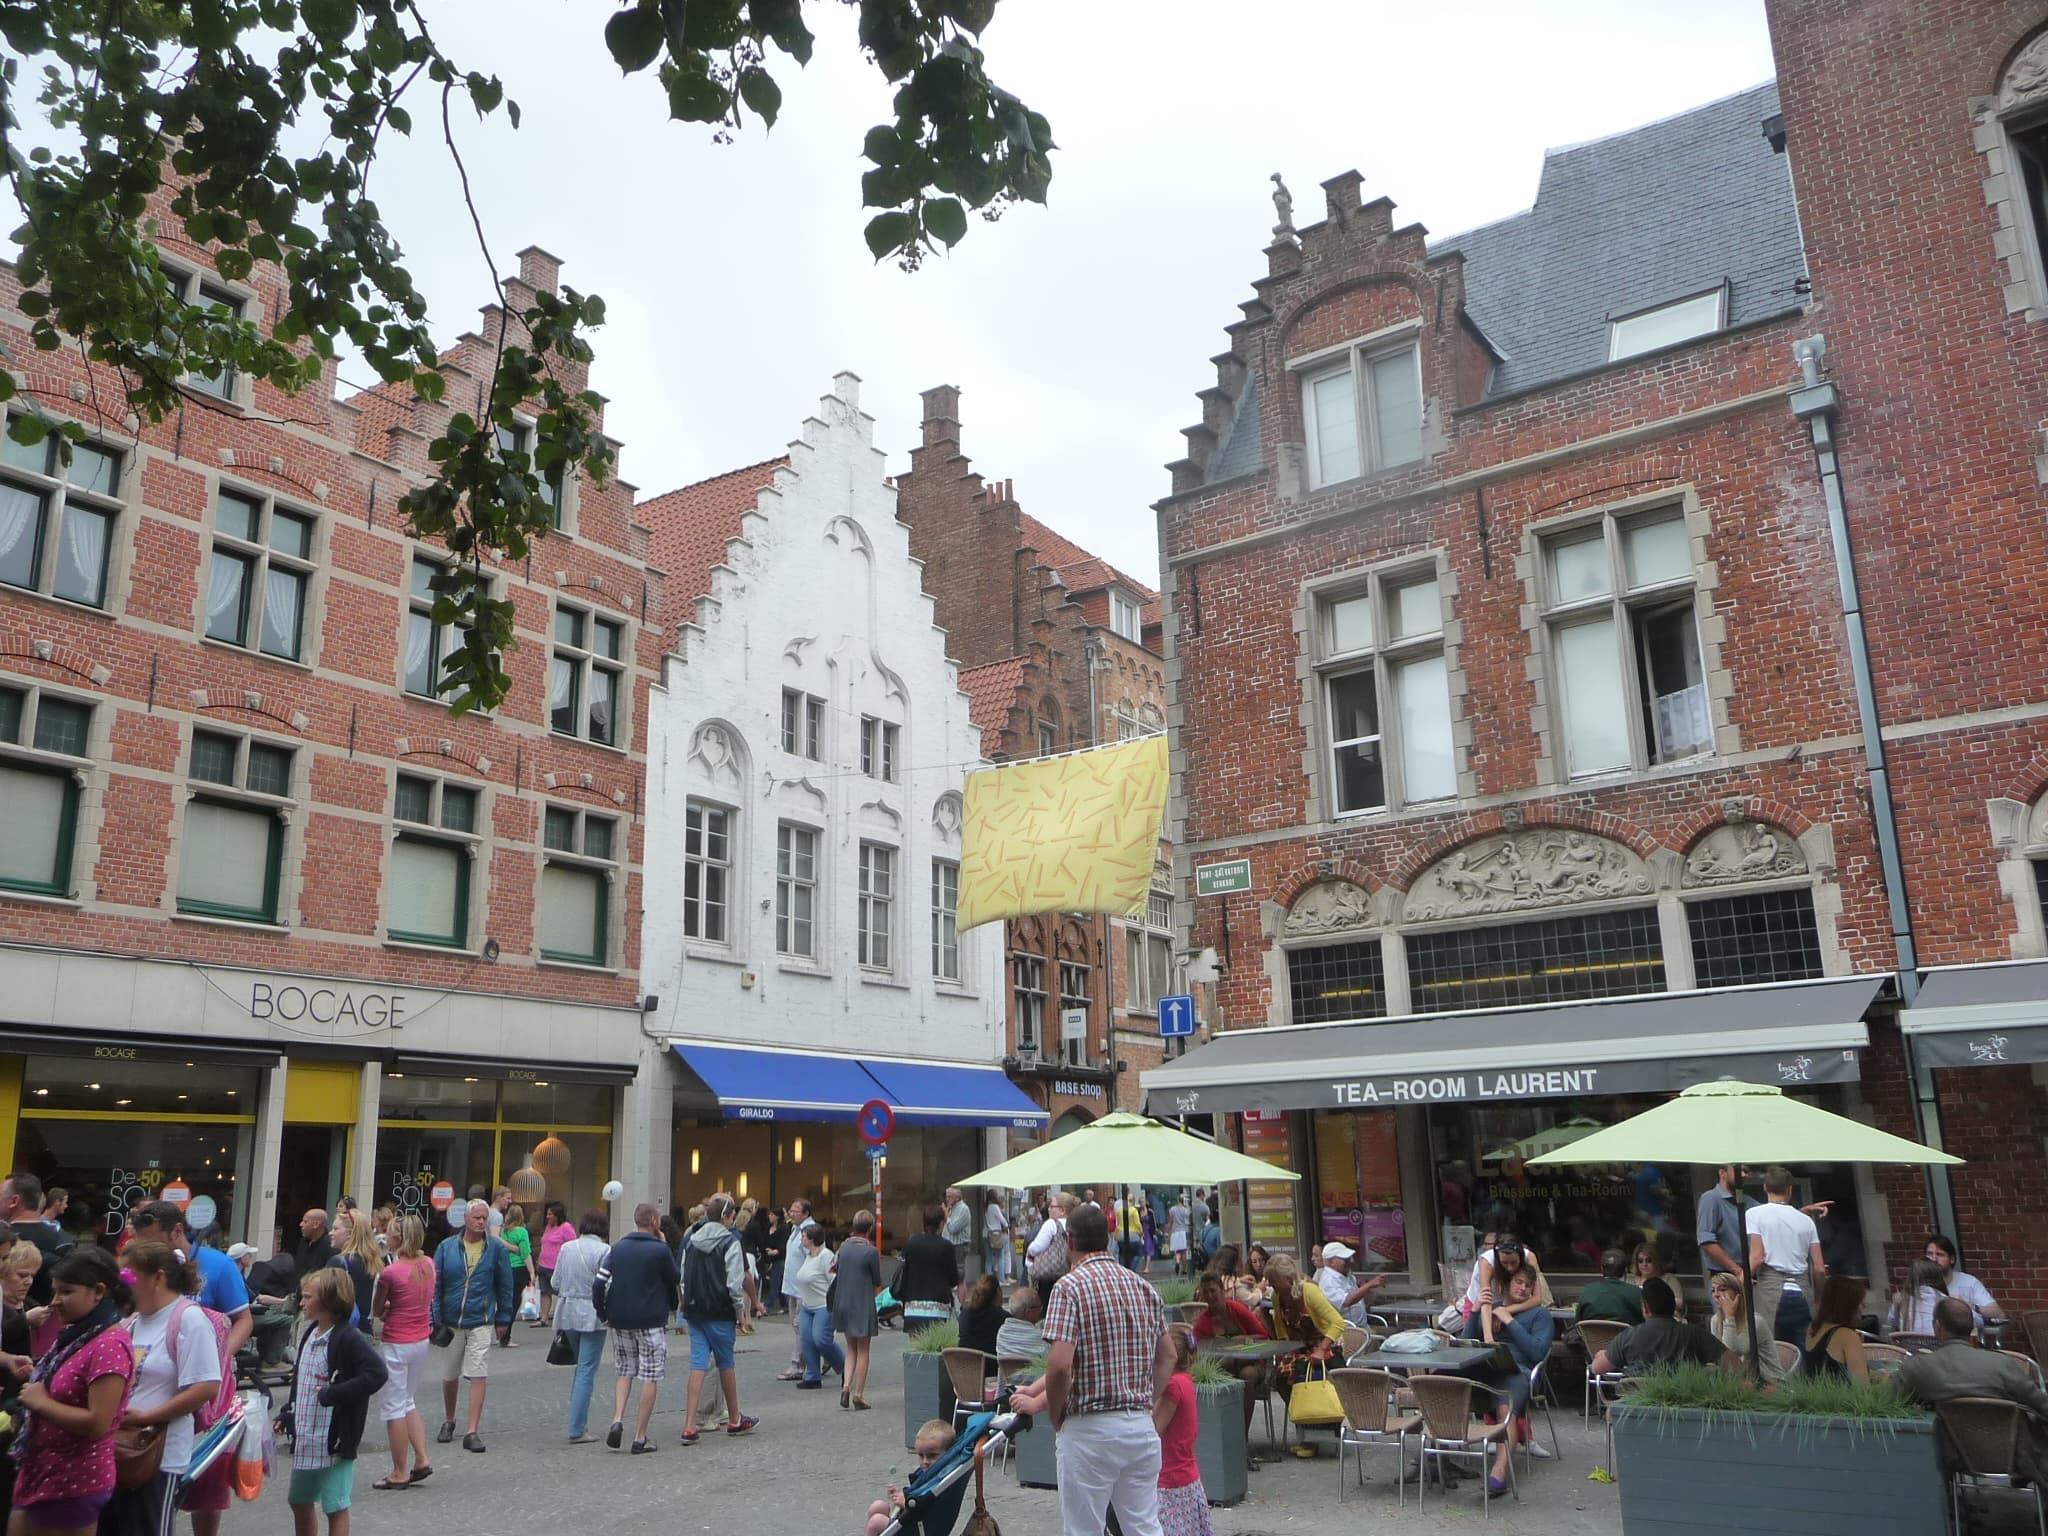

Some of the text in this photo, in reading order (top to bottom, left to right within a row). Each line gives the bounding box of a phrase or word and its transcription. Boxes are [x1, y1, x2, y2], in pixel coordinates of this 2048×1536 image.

[251, 983, 405, 1029] BOCAGE
[94, 1046, 137, 1059] BOCAGE
[1055, 1080, 1102, 1100] BASE shop
[1332, 1069, 1598, 1104] TEA-ROOM LAURENT
[739, 1107, 774, 1119] GIRALDO
[1013, 1118, 1038, 1128] GIRALDO
[111, 1168, 136, 1185] De
[393, 1171, 411, 1186] De
[108, 1185, 152, 1210] SO
[392, 1186, 429, 1208] SOL
[1552, 1183, 1561, 1198] &
[1566, 1182, 1632, 1198] Tea-Room
